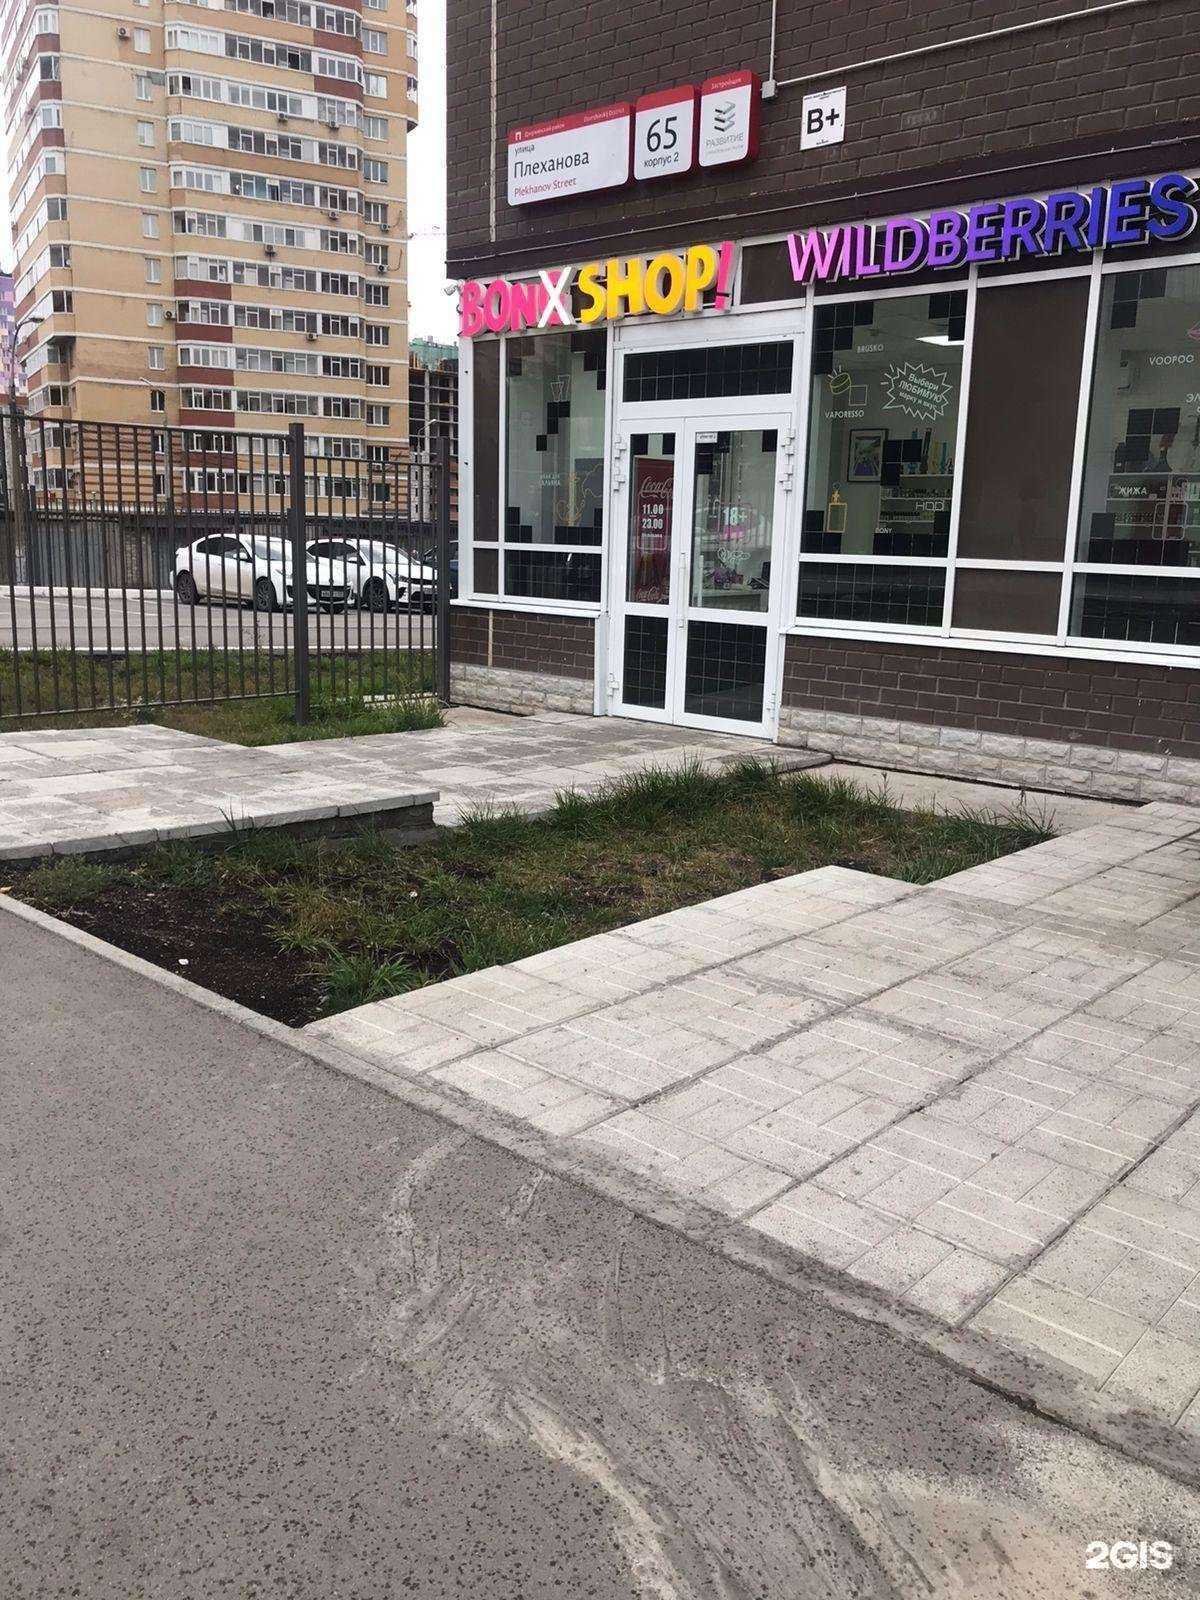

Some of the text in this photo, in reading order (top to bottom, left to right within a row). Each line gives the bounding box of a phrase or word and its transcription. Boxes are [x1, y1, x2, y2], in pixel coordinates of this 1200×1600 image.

[646, 116, 678, 152] 65
[514, 144, 535, 156] улица
[514, 151, 590, 179] Плеханова
[644, 152, 679, 168] корпус 2
[514, 178, 577, 198] Plekhanov Street
[786, 173, 1199, 283] WILDBERRIES
[578, 240, 736, 325] SHOP!
[898, 380, 942, 403] ЛЮБИМУЮ
[908, 373, 939, 392] Выбери
[824, 409, 865, 418] VAPORESSO
[642, 503, 664, 515] 11.00
[641, 518, 663, 530] 23.00
